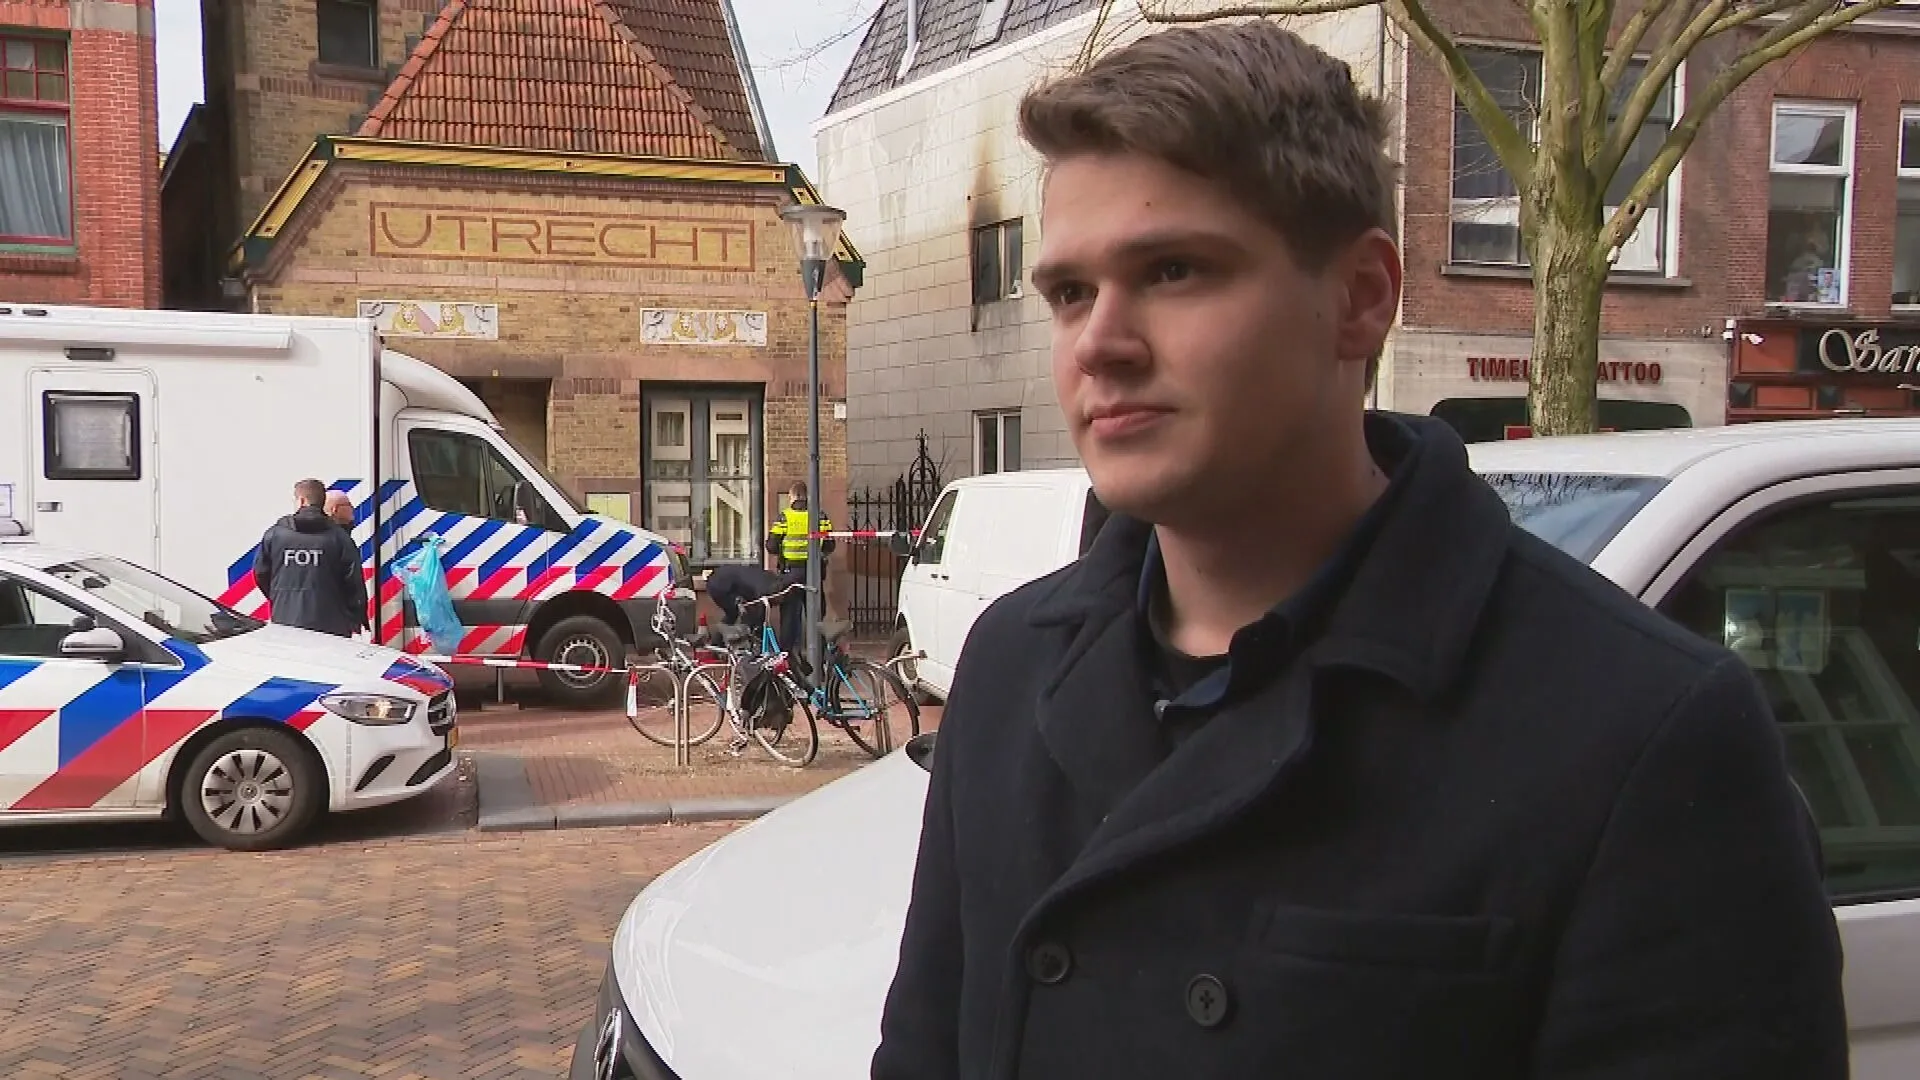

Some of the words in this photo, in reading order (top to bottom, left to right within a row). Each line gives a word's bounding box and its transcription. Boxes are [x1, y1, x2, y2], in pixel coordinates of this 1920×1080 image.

[380, 211, 747, 263] UTRECHT
[1466, 357, 1530, 378] TIMEL
[1597, 361, 1661, 383] ATTOO
[284, 549, 323, 567] FOT
